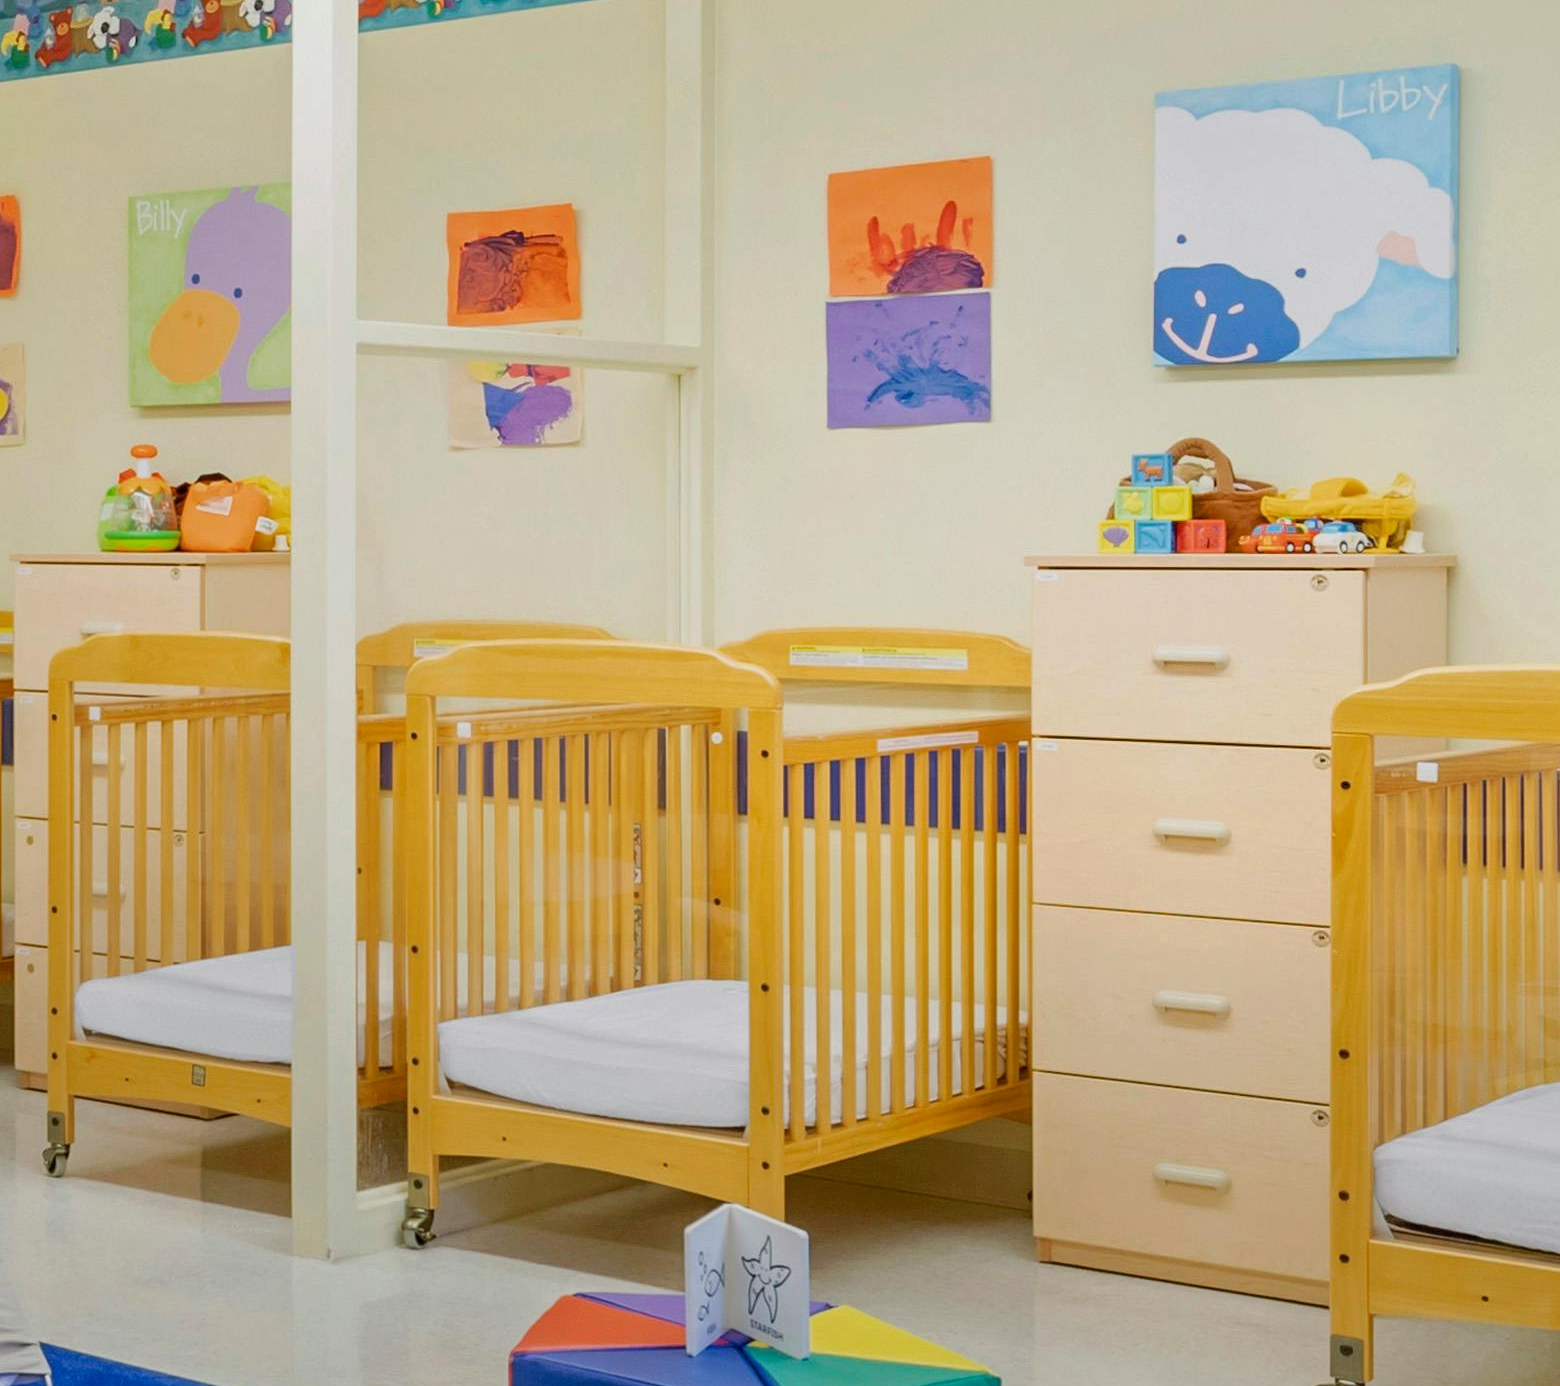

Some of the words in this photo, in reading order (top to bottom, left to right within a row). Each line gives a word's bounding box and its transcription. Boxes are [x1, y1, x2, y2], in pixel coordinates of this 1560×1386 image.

[1336, 76, 1448, 121] Libby
[136, 200, 188, 239] Billy
[749, 1318, 784, 1341] STARFISH
